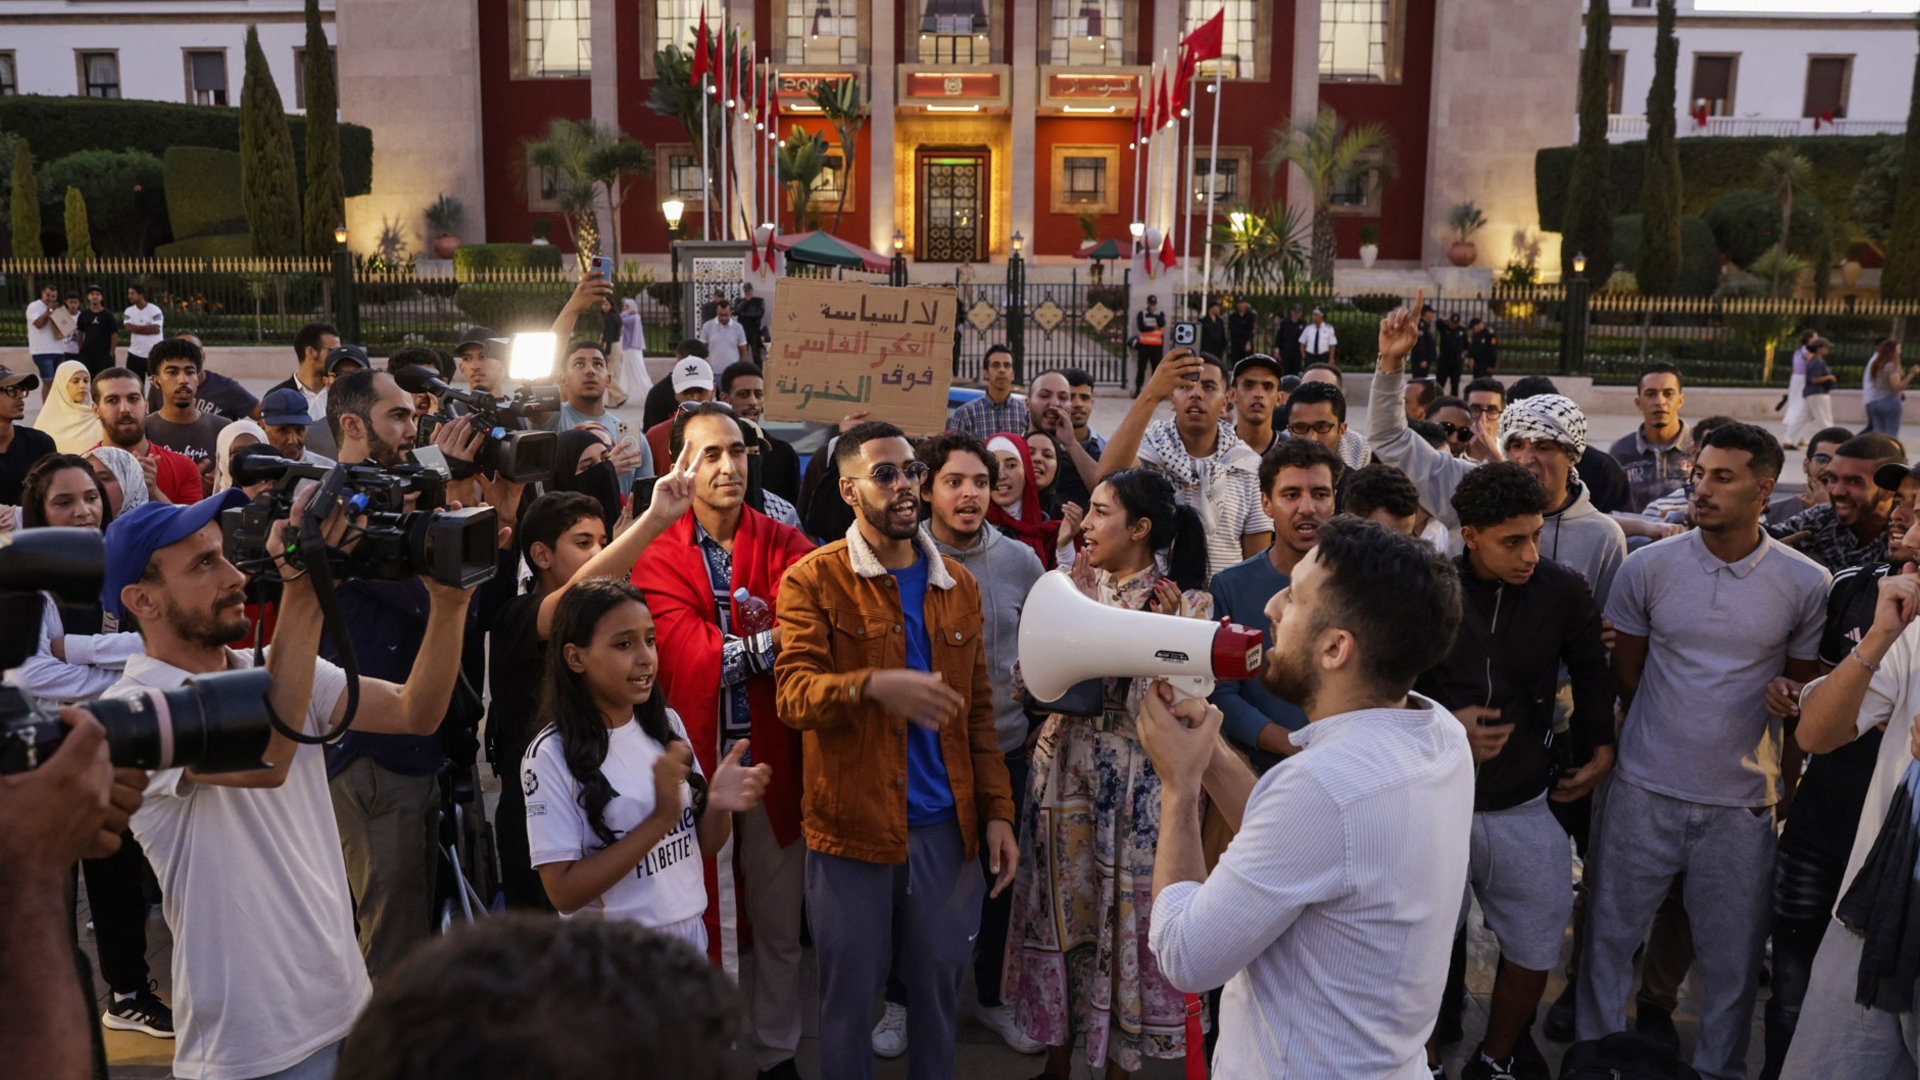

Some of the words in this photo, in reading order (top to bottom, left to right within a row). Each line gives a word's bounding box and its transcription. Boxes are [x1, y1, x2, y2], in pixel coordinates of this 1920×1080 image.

[821, 294, 909, 327] لسياسة
[912, 300, 938, 325] لا
[783, 328, 869, 366] الفاسي
[869, 332, 936, 369] العكر
[776, 374, 872, 410] الخنونة
[881, 363, 933, 392] فوق
[658, 834, 694, 870] BETTE
